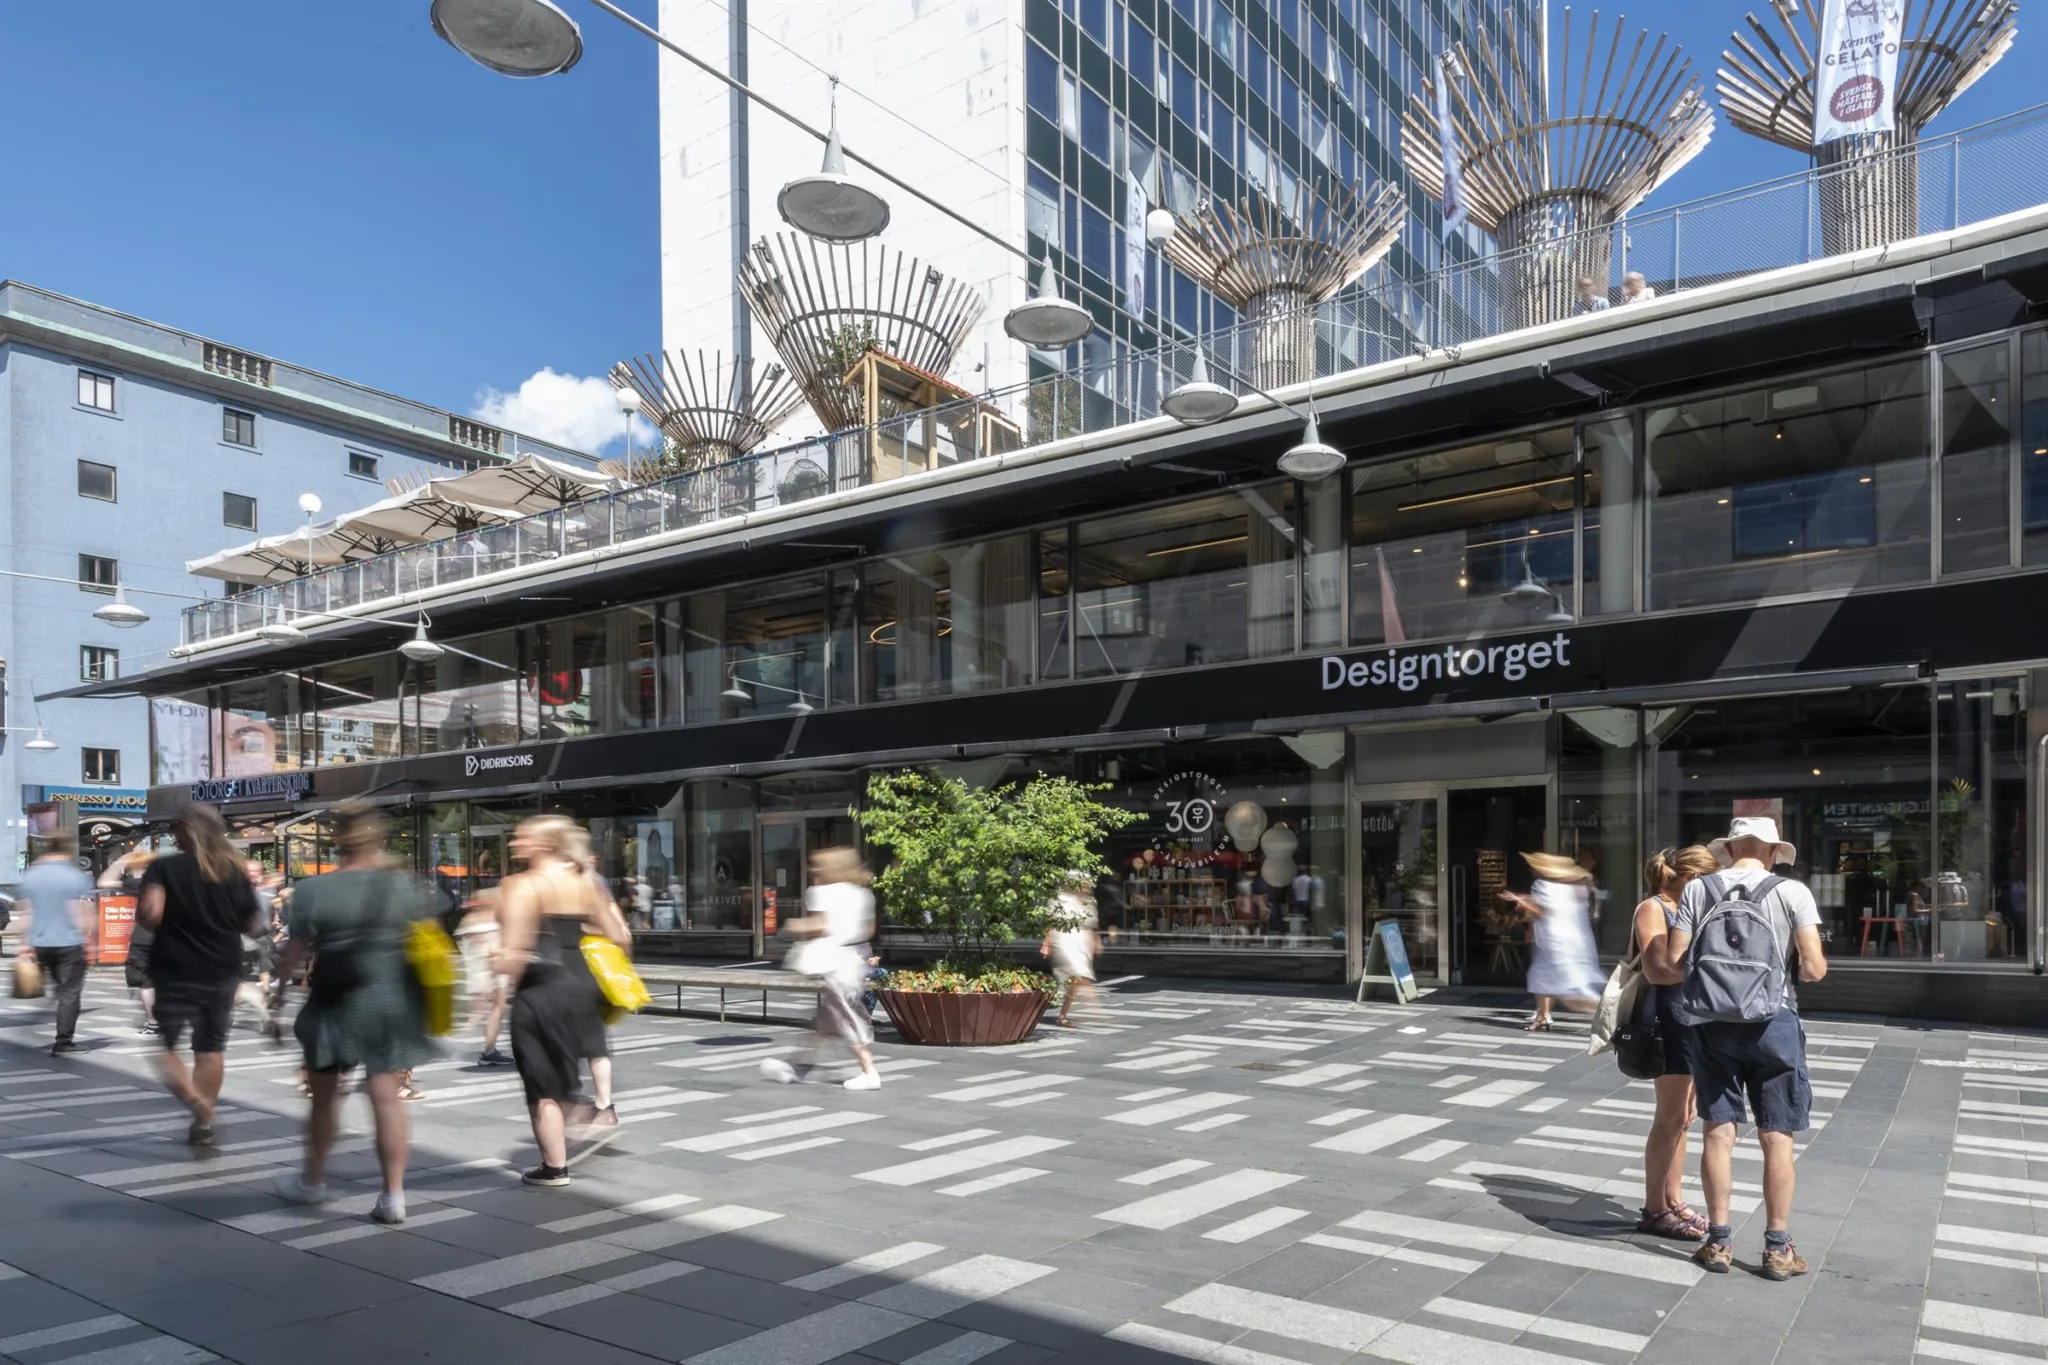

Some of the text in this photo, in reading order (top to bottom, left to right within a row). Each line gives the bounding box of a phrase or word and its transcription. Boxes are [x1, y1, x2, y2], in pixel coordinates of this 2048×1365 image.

[1839, 31, 1885, 51] Kennys
[1824, 42, 1898, 66] GELATO
[1839, 82, 1873, 101] SVENSK
[1845, 100, 1876, 114] GLASS!
[1322, 632, 1571, 692] Designtorget
[480, 754, 534, 770] DIDRIKSONS
[49, 793, 148, 806] ESPRESSO HOU
[1165, 798, 1213, 833] 30
[702, 895, 742, 905] ARKIVET
[1172, 923, 1236, 937] Designtorget
